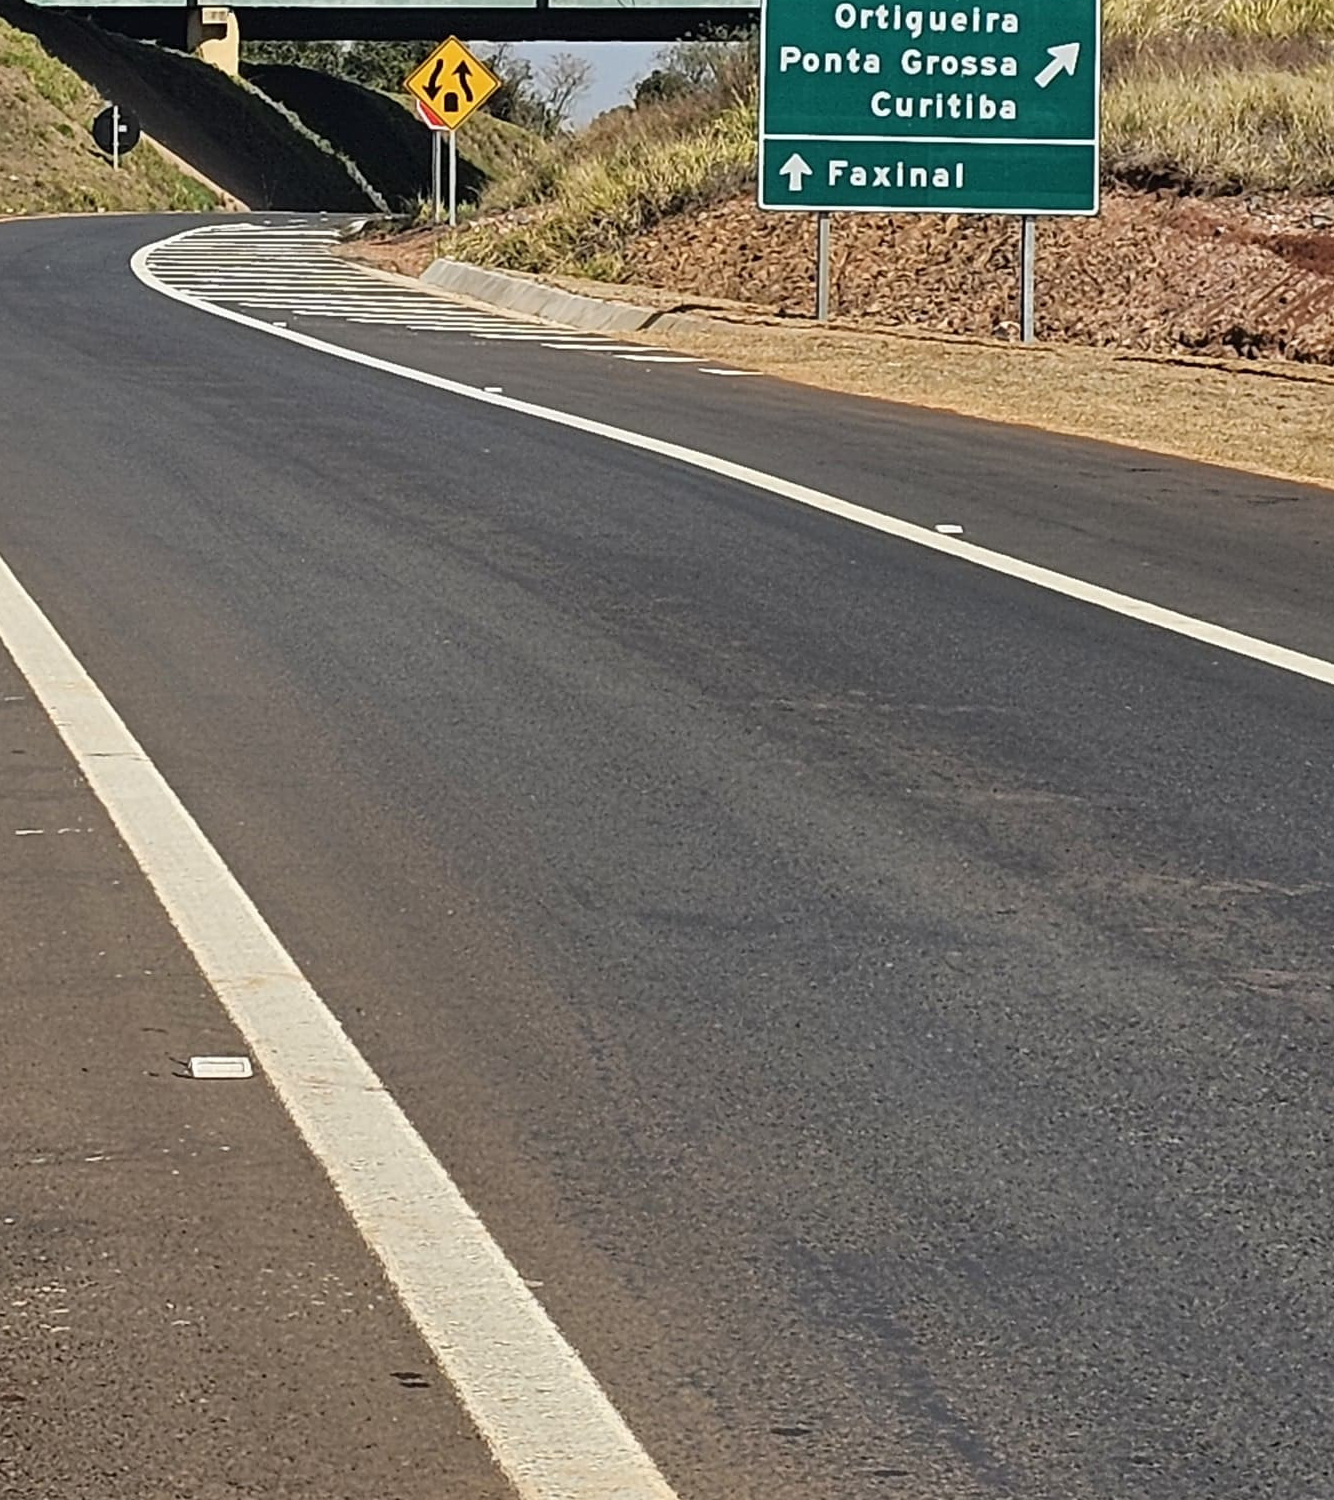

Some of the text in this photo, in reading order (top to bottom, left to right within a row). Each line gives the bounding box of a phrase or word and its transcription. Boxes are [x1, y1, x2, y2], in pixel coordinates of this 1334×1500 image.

[834, 3, 1019, 39] Ortigueira
[780, 46, 1017, 77] Ponta Grossa
[871, 90, 1016, 120] Curitiba
[828, 160, 964, 189] Faxinal
